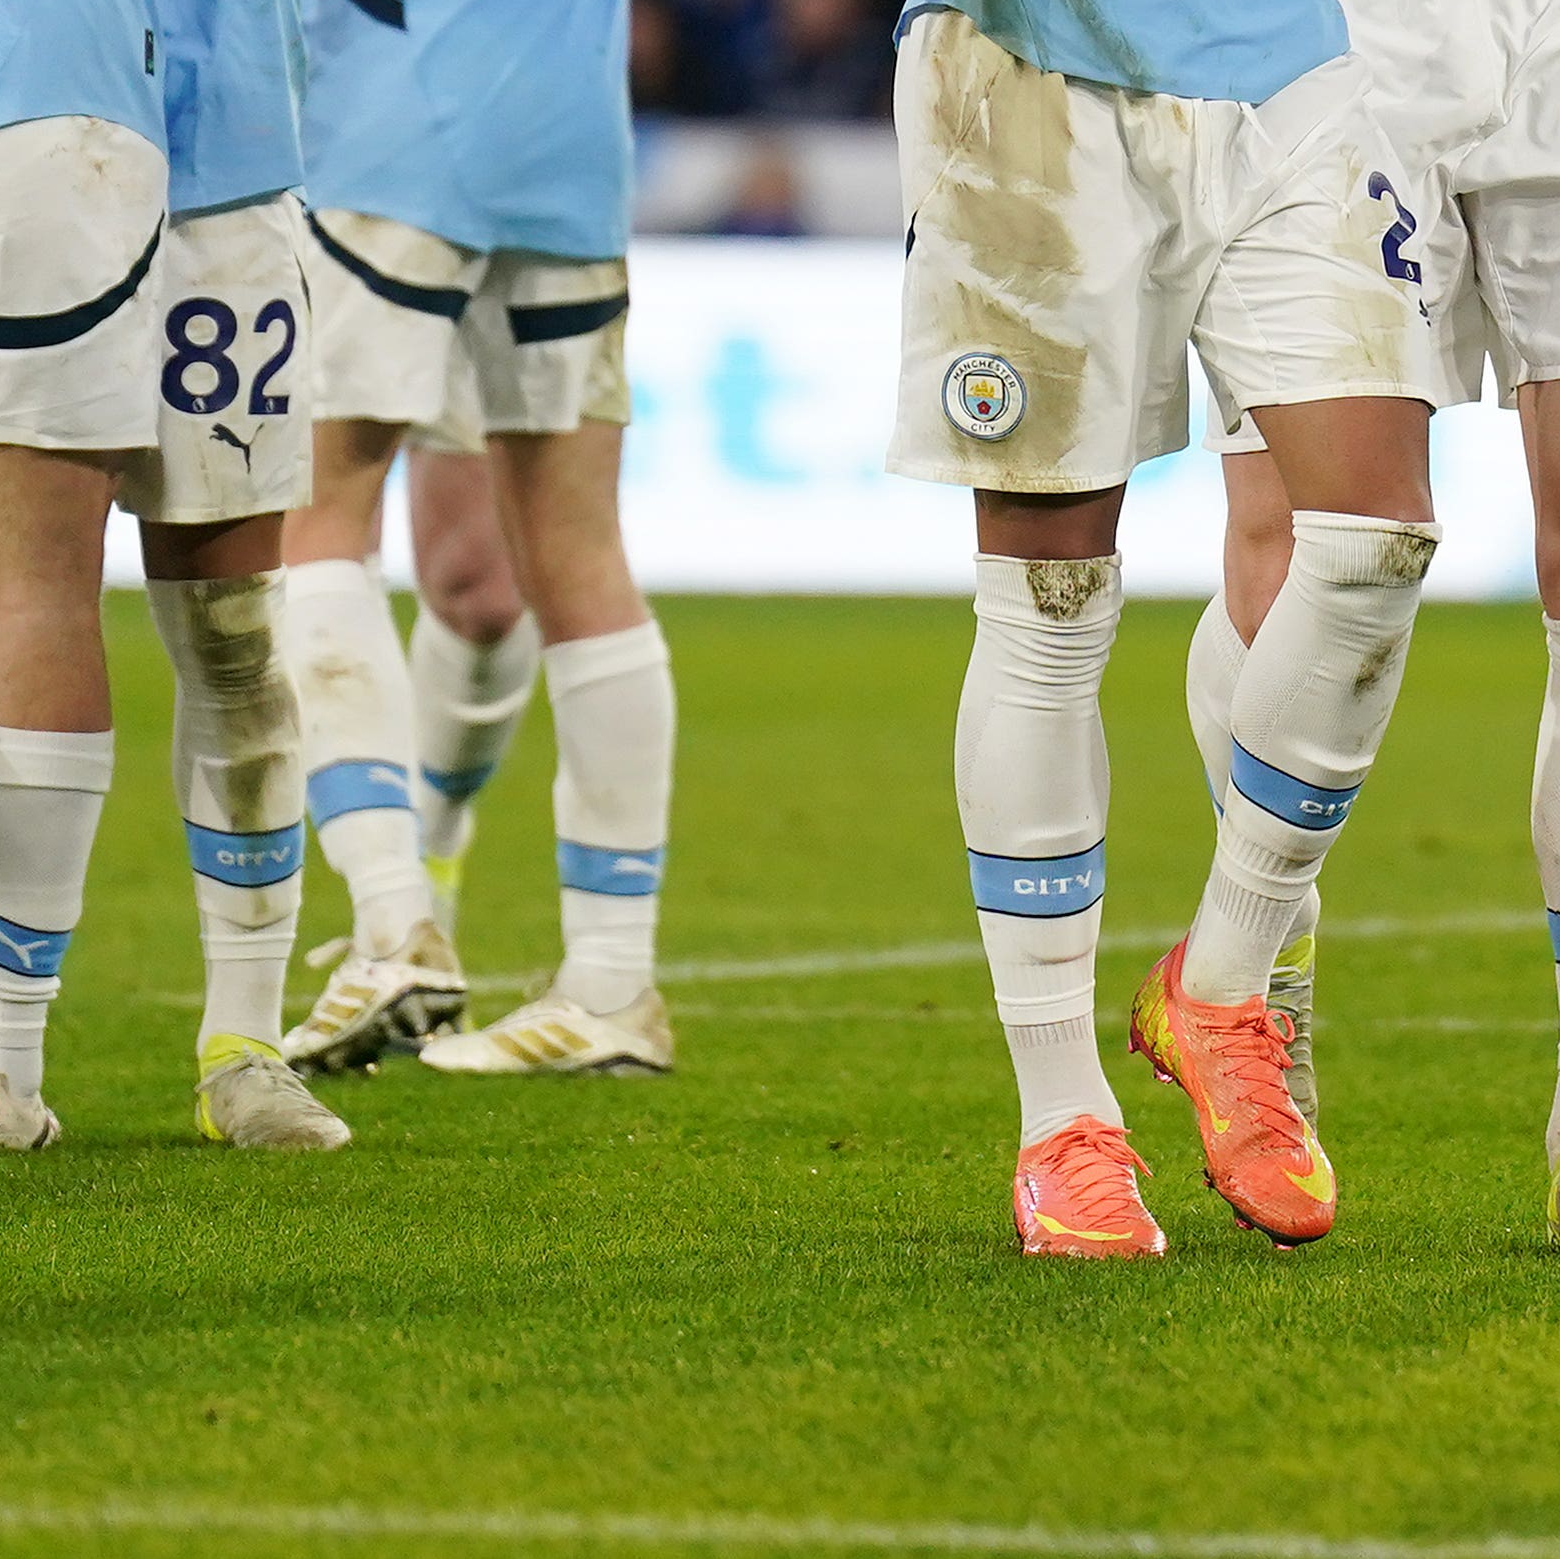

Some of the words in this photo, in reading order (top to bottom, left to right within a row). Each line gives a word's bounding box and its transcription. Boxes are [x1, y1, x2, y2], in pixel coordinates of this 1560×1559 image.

[1367, 171, 1422, 285] 2
[160, 296, 298, 416] 82
[952, 359, 1017, 390] MANCHESTER
[970, 423, 996, 433] CITY
[1013, 869, 1093, 896] CITY
